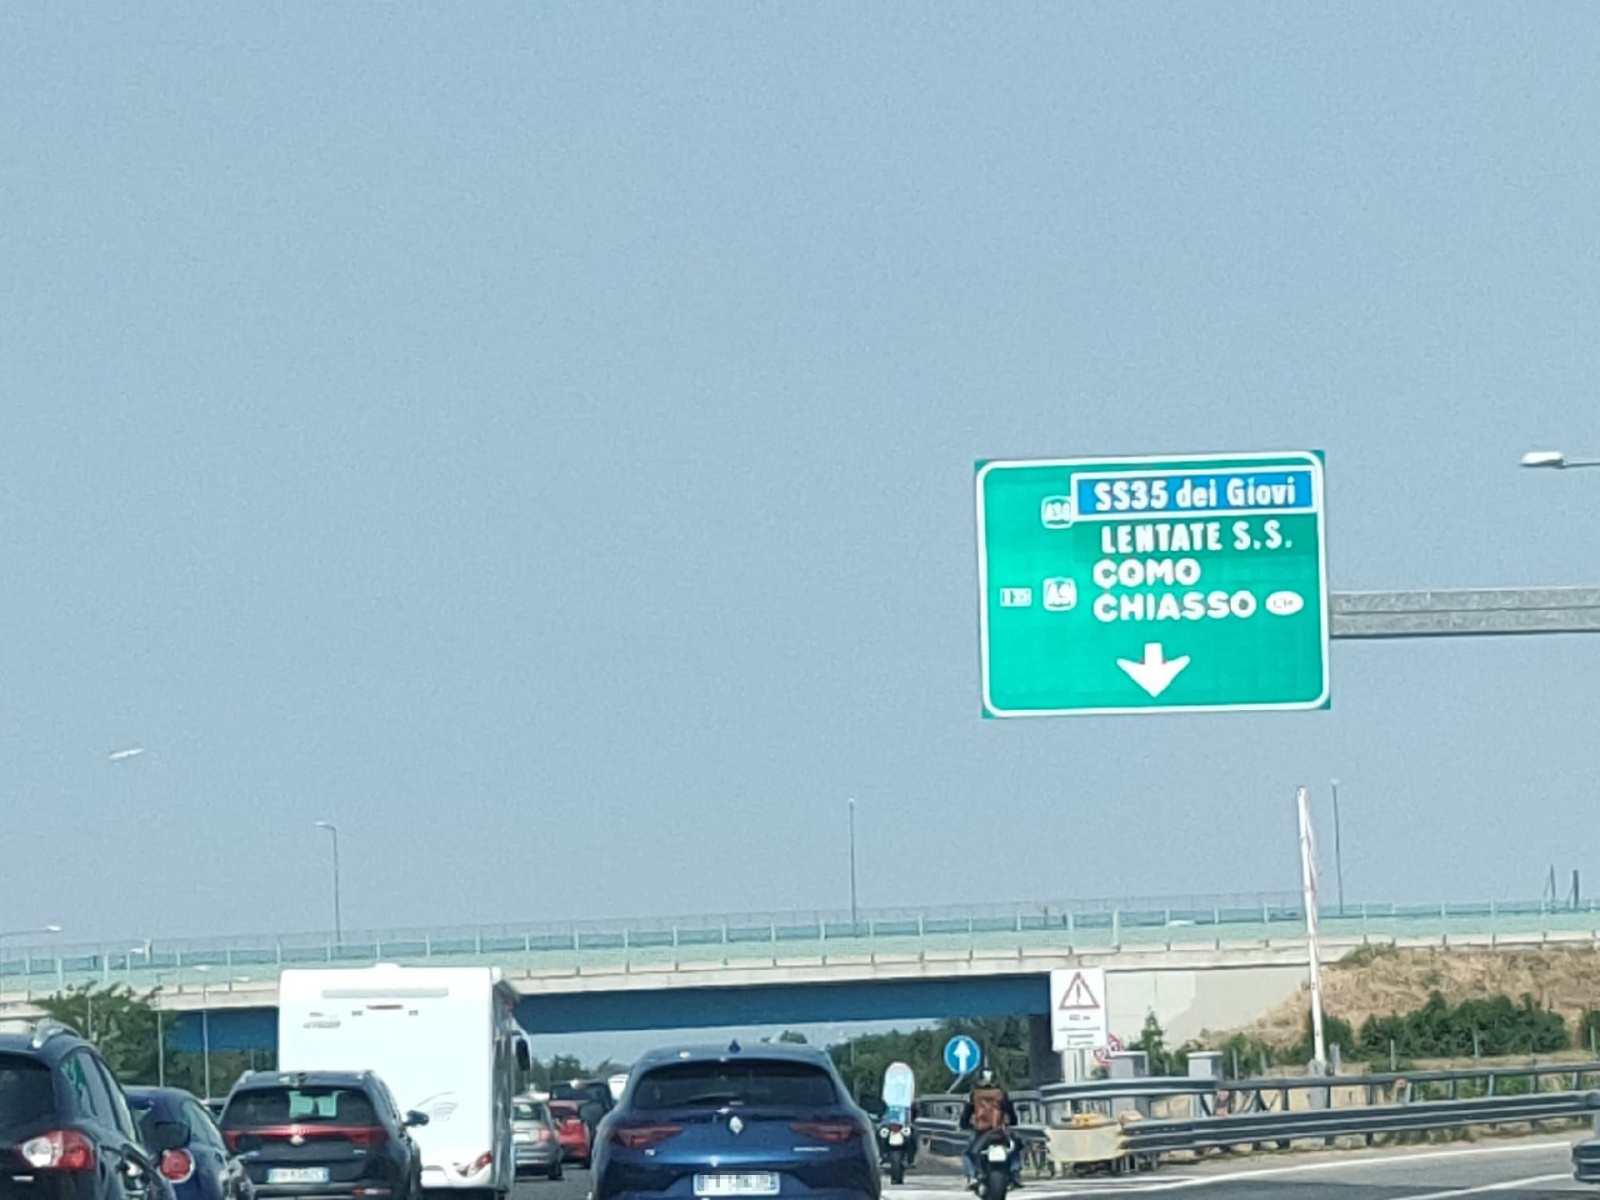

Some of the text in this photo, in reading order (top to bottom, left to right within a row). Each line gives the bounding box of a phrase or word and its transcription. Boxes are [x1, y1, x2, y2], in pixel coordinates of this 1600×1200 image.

[1094, 476, 1295, 512] SS35 dei Giovi
[1101, 520, 1292, 553] LENTATE S.S.
[1093, 558, 1201, 588] COMO
[1093, 590, 1257, 622] CHIASSO
